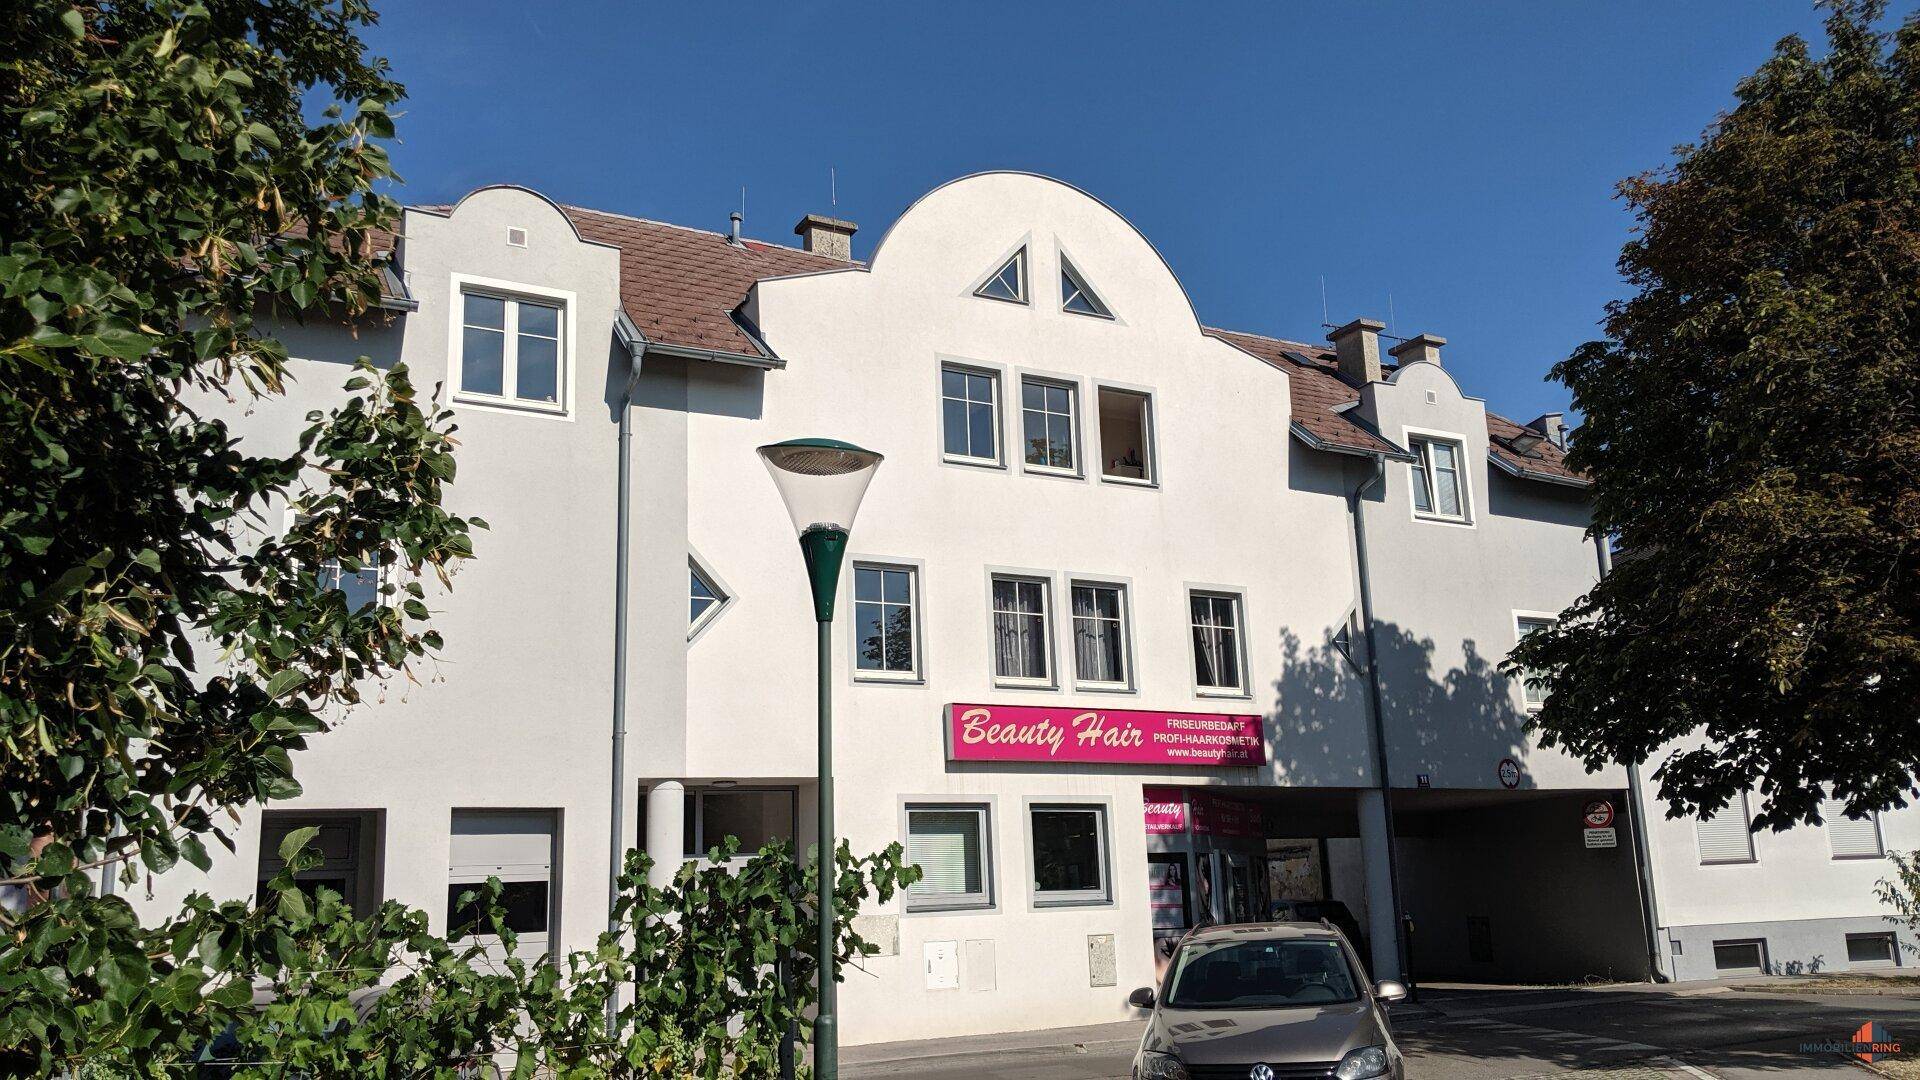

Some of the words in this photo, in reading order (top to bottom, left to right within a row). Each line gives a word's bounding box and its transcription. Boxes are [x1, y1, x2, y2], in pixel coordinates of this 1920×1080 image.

[1167, 719, 1246, 731] FRISEURBEDARF
[961, 708, 1064, 756] Beauty
[1072, 712, 1144, 747] Hair
[1153, 733, 1260, 746] PROFI-HAARKOSMETIK
[1167, 748, 1249, 760] www.beautyhair.at
